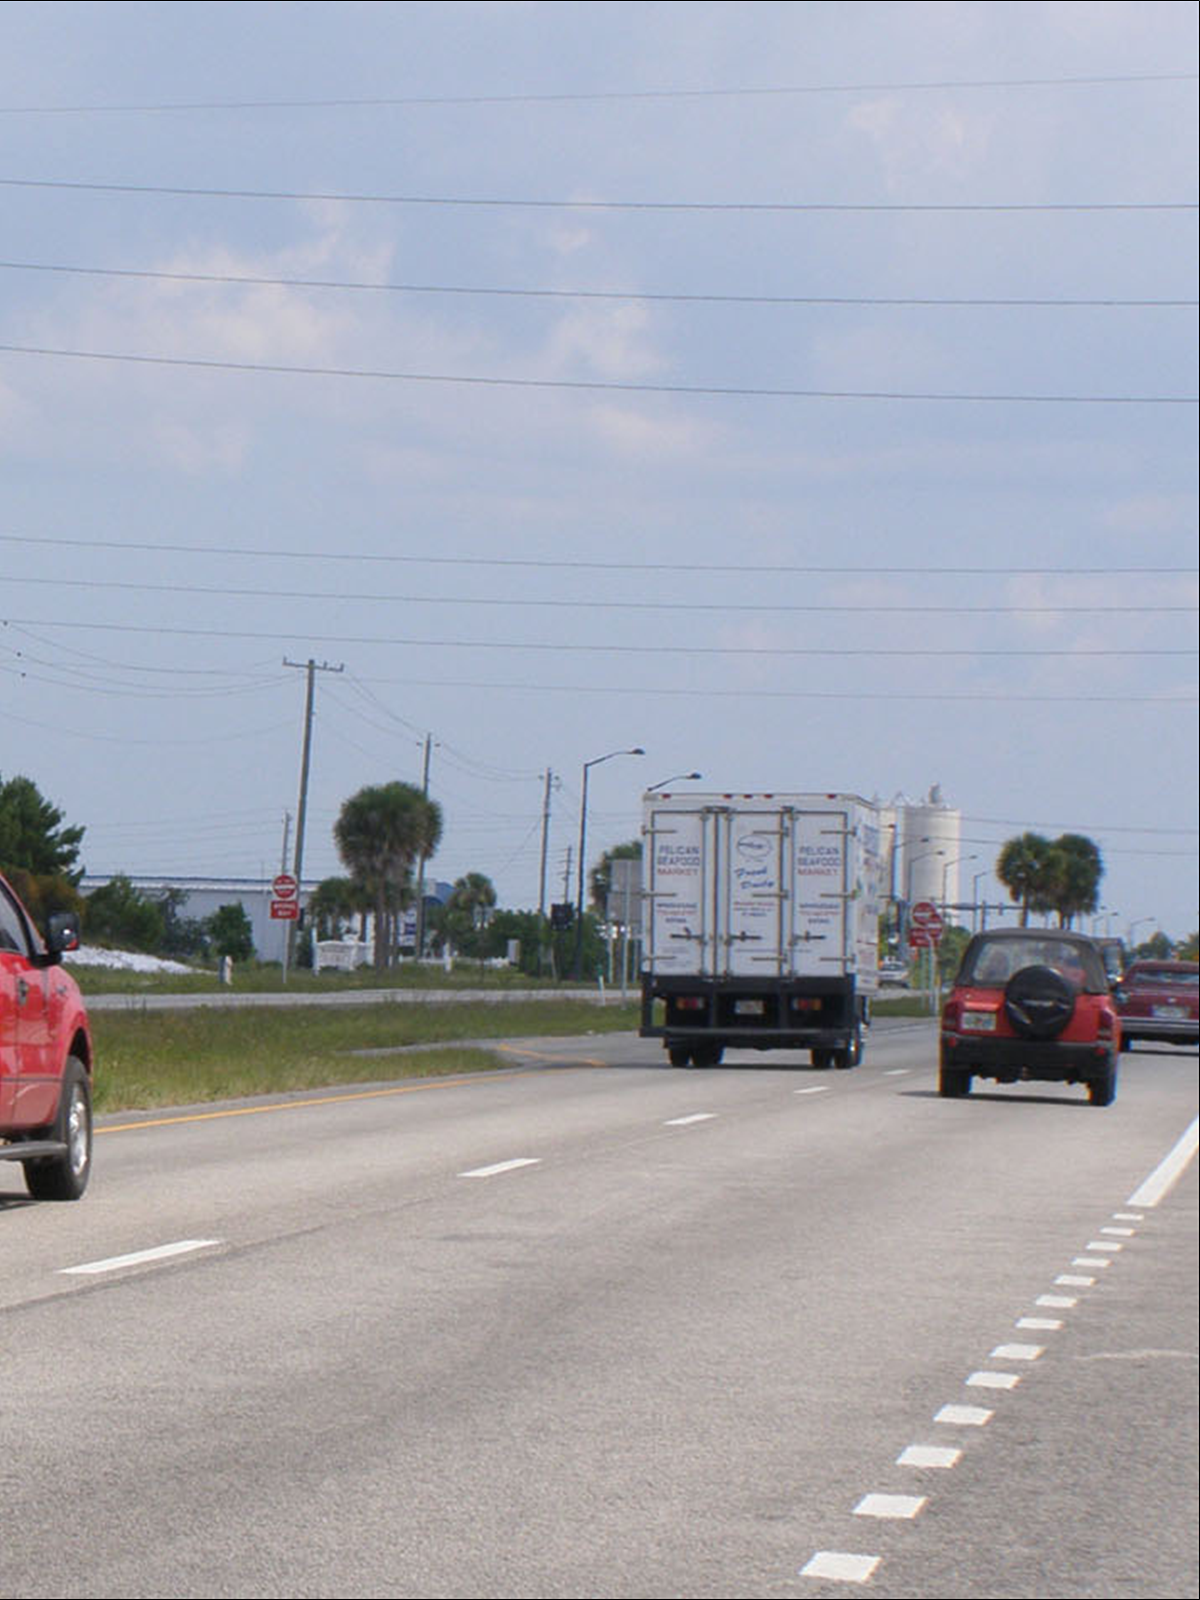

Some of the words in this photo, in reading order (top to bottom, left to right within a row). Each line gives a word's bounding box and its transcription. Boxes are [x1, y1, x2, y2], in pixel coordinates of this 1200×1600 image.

[658, 845, 700, 855] PELICAN
[799, 846, 840, 856] PELICAN
[657, 856, 701, 867] SEAFOOD
[797, 856, 841, 867] SEAFOOD
[657, 867, 699, 876] MARKET
[797, 868, 838, 876] MARKET
